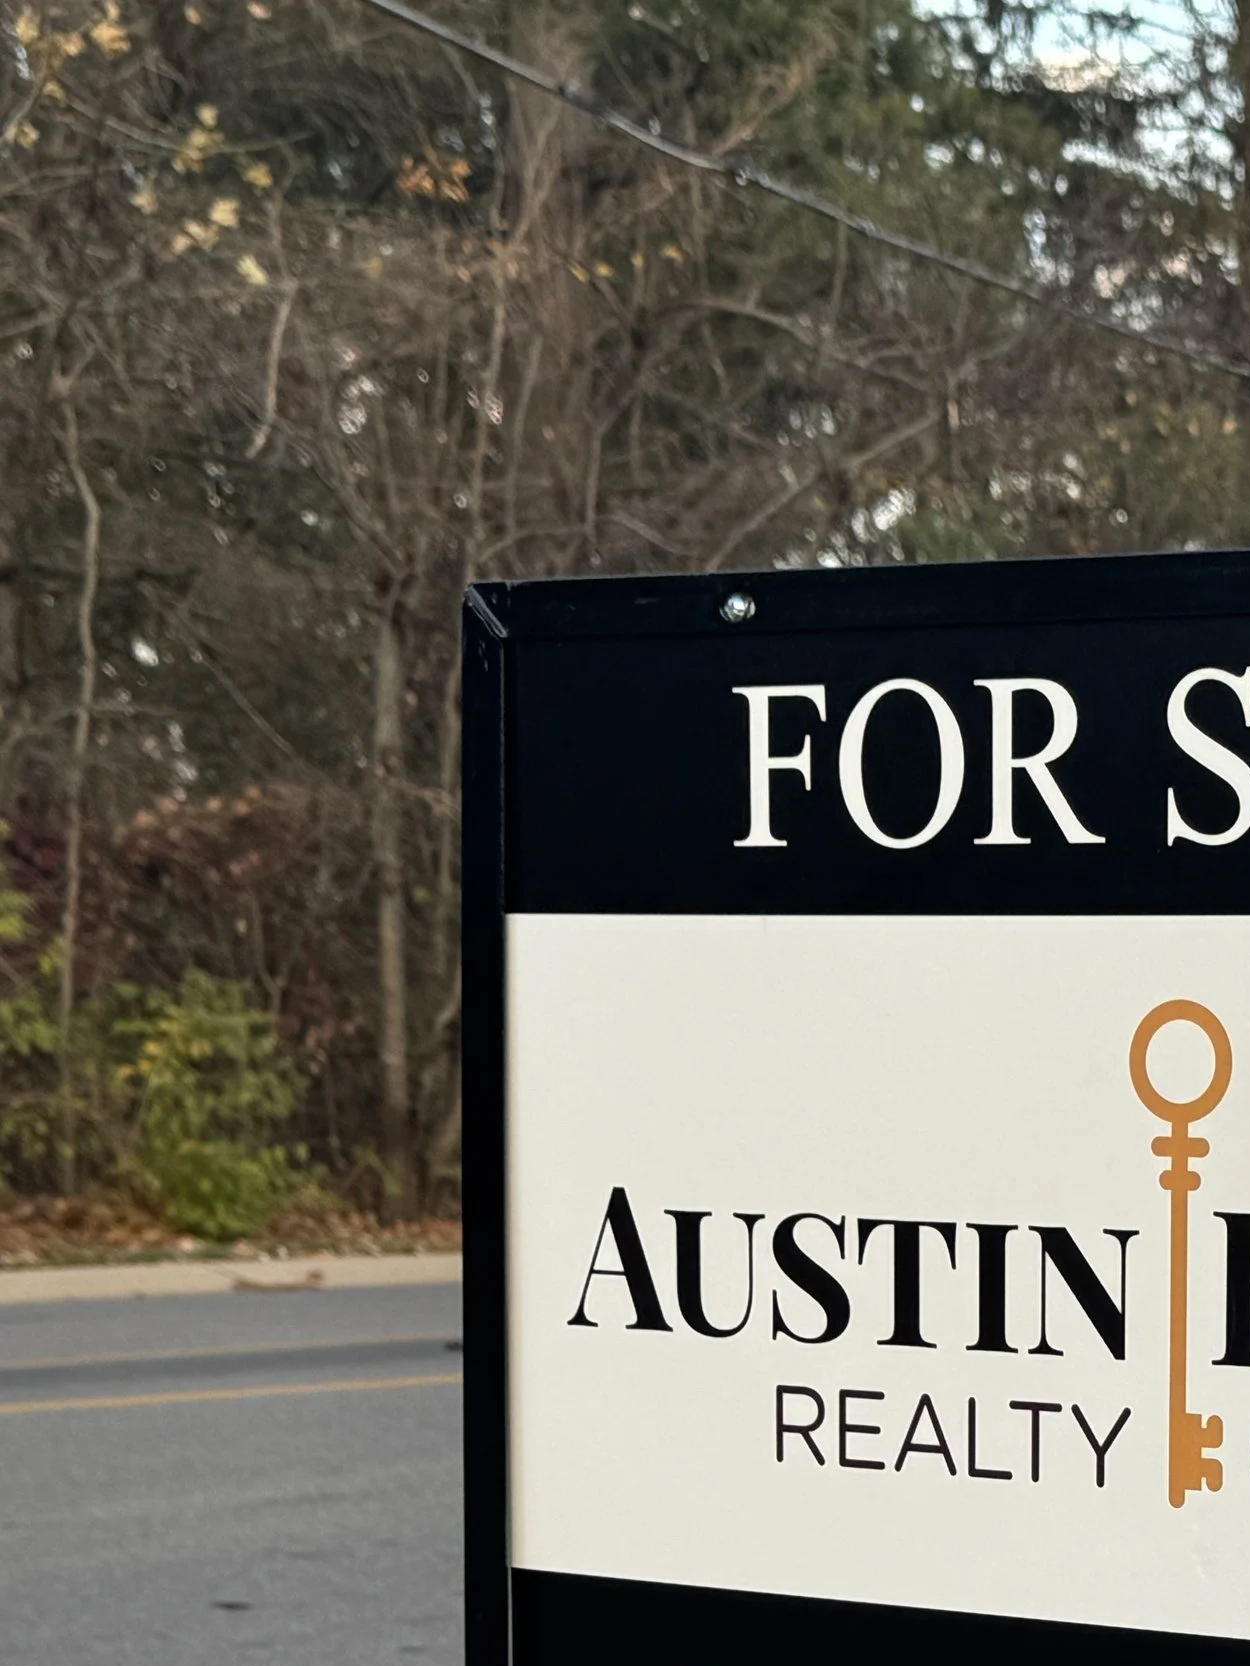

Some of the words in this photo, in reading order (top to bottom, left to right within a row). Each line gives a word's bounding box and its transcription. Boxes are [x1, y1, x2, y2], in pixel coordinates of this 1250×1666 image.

[732, 678, 1105, 848] FOR
[567, 1187, 1140, 1360] AUSTIN
[775, 1384, 1132, 1488] REALTY
